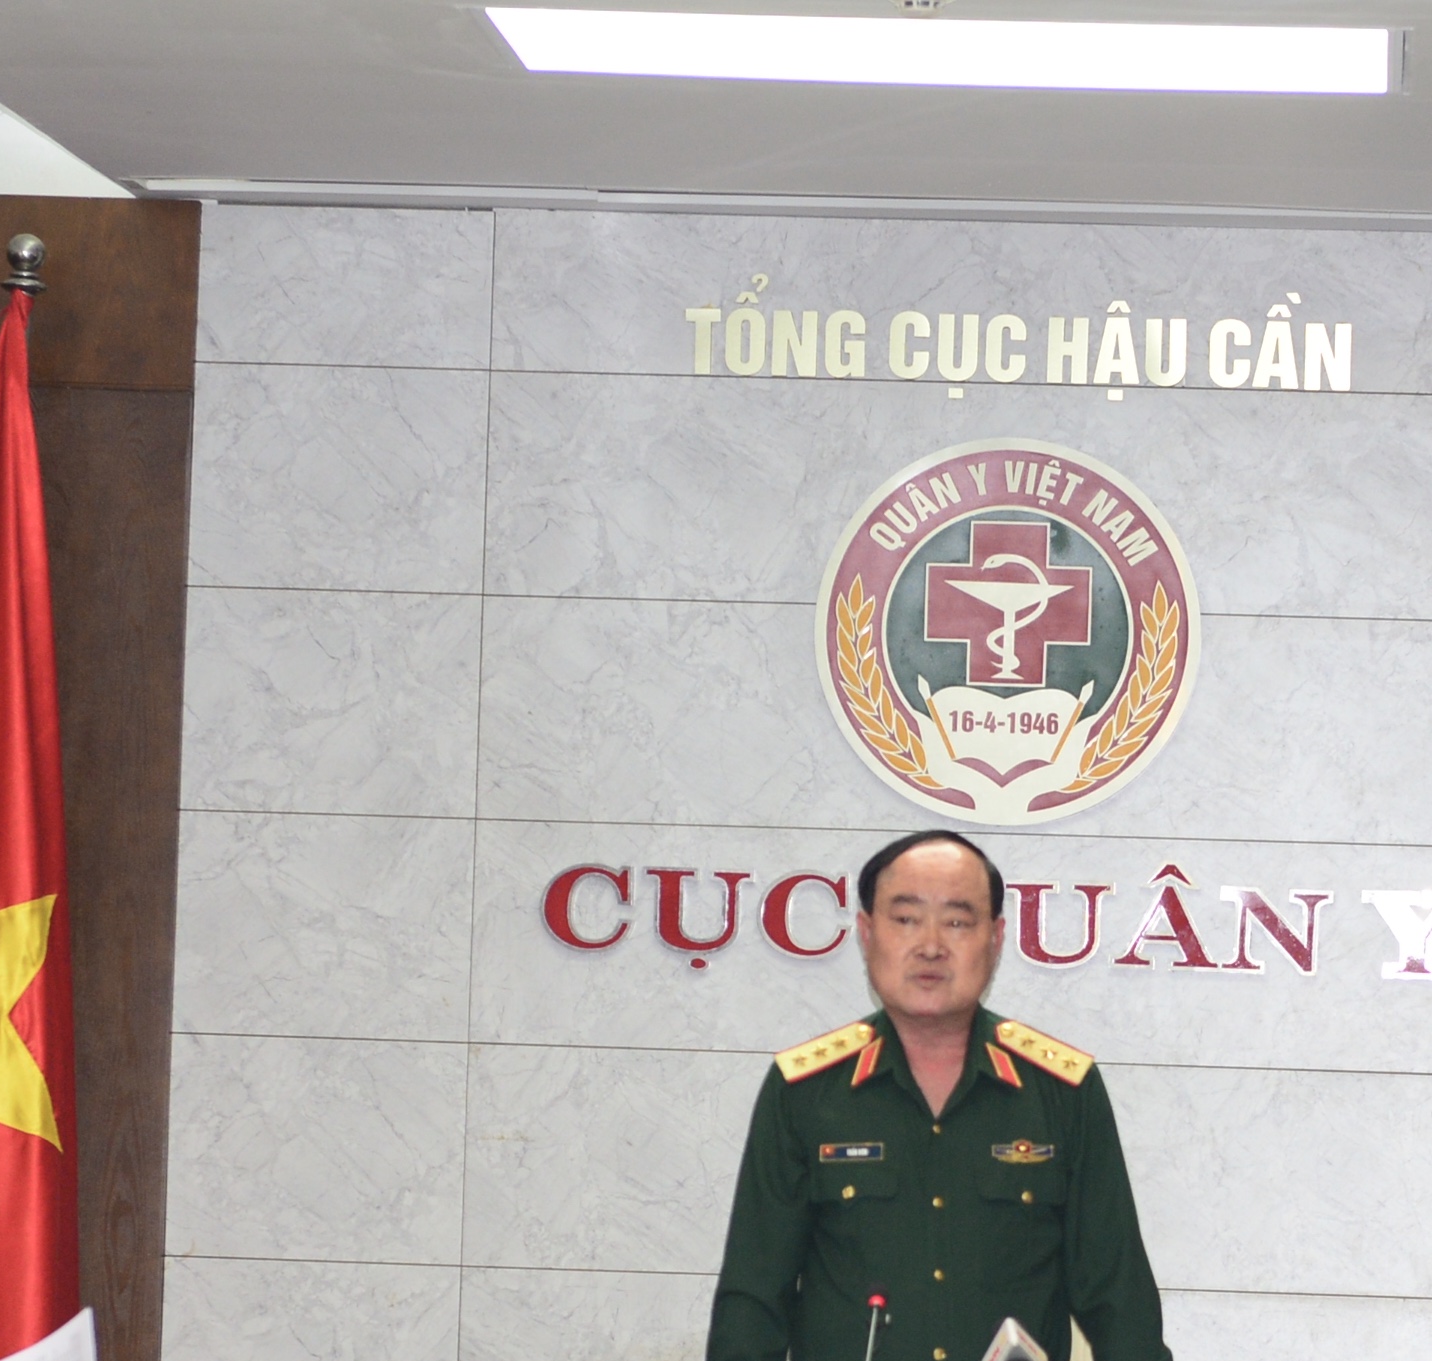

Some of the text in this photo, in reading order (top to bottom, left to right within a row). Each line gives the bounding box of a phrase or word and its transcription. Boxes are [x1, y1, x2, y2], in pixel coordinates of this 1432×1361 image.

[685, 273, 1353, 401] TỔNG CỤC HẬU CẦN
[869, 458, 1159, 567] QUÂN Y VIỆT NAM
[948, 710, 1060, 736] 16-4-1946
[540, 863, 852, 971] CỤC
[1004, 863, 1335, 976] UÂN
